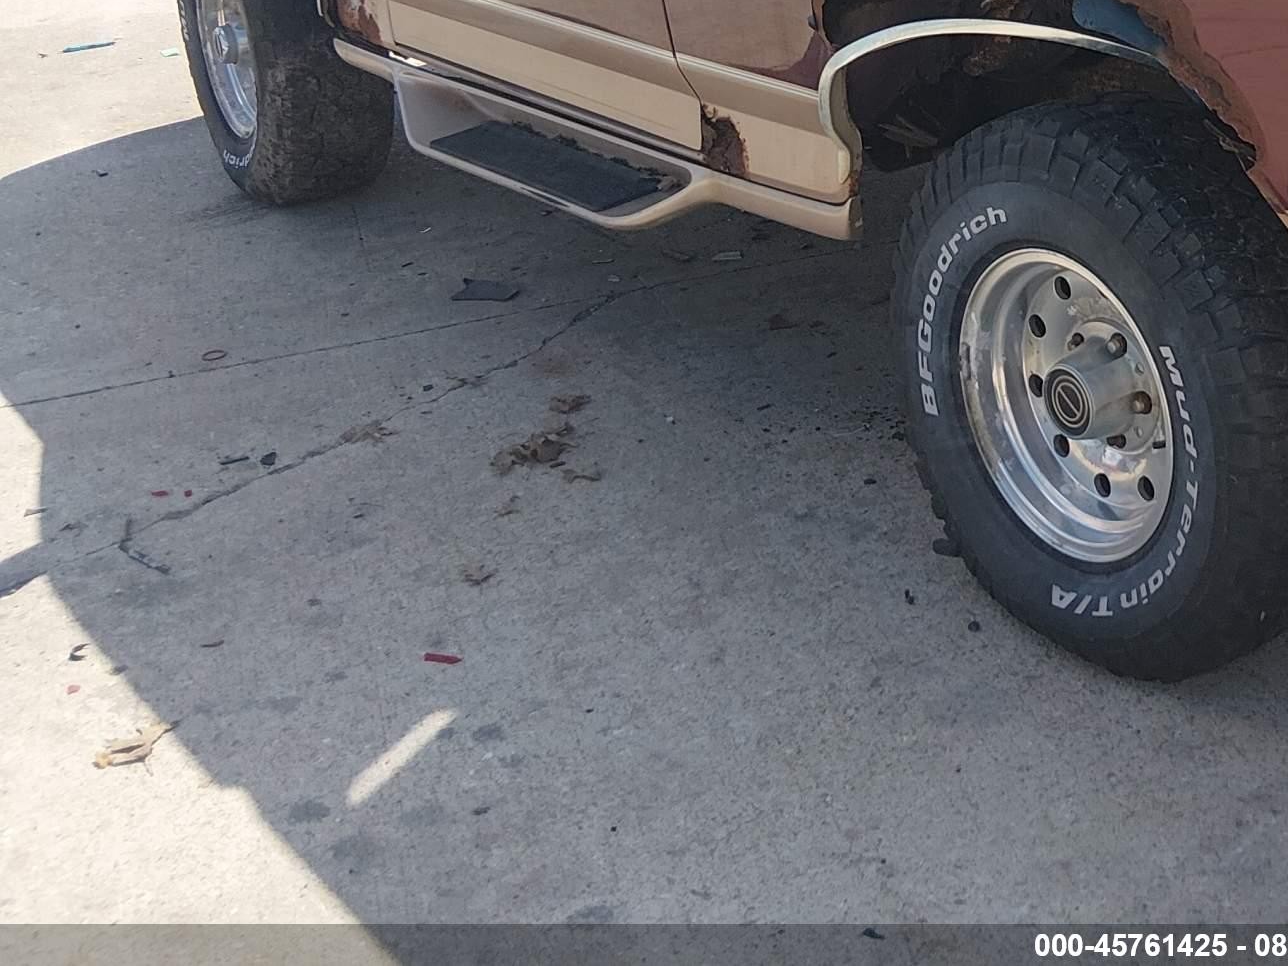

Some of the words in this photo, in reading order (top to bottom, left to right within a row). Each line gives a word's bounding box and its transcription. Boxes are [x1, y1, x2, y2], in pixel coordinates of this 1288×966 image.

[917, 206, 1008, 417] BFGoodrich
[1120, 345, 1199, 609] Mud-Terrain
[1051, 583, 1114, 617] T/A
